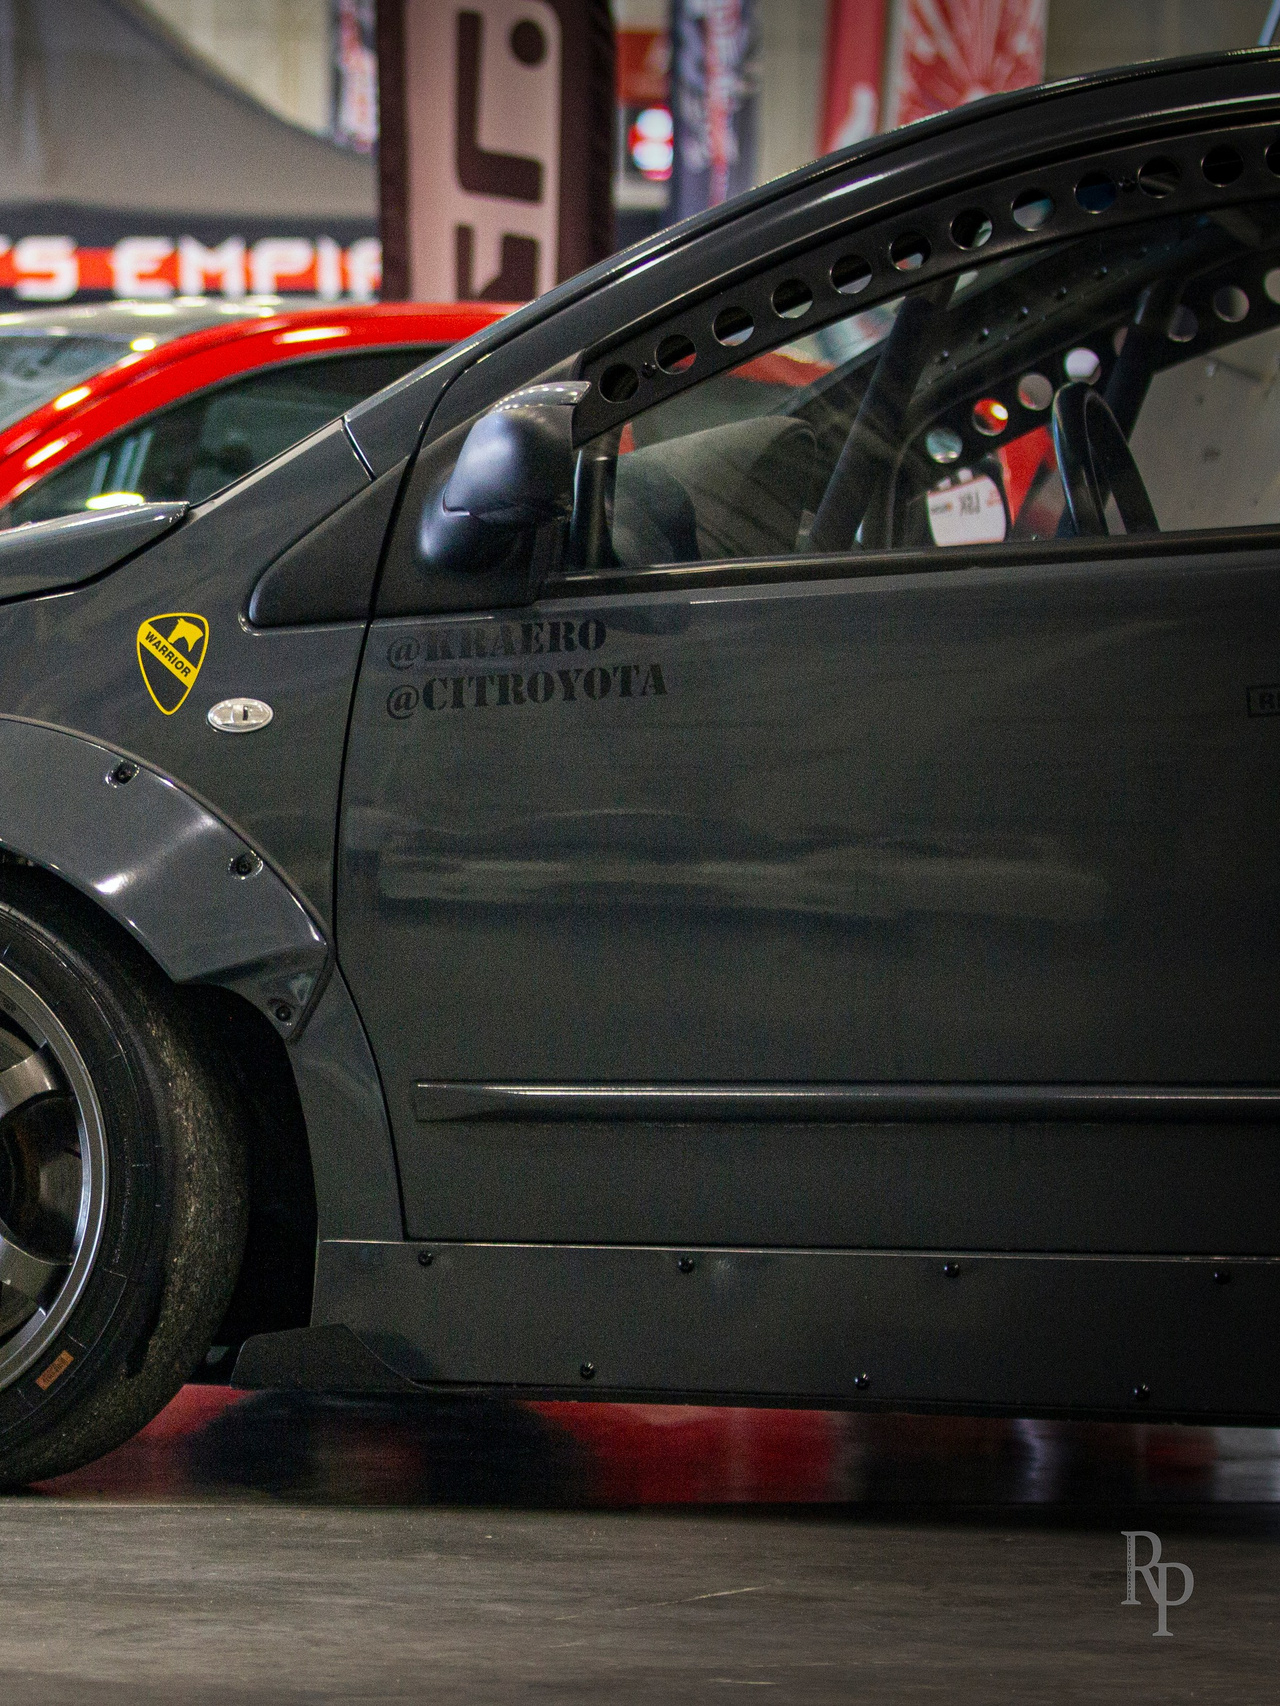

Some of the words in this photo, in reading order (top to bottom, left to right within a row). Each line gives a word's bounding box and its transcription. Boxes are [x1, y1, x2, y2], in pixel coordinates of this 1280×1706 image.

[145, 631, 191, 677] WARRIOR
[386, 618, 607, 671] @KRAERO
[385, 664, 668, 720] @CITROYOTA
[1259, 692, 1280, 710] R
